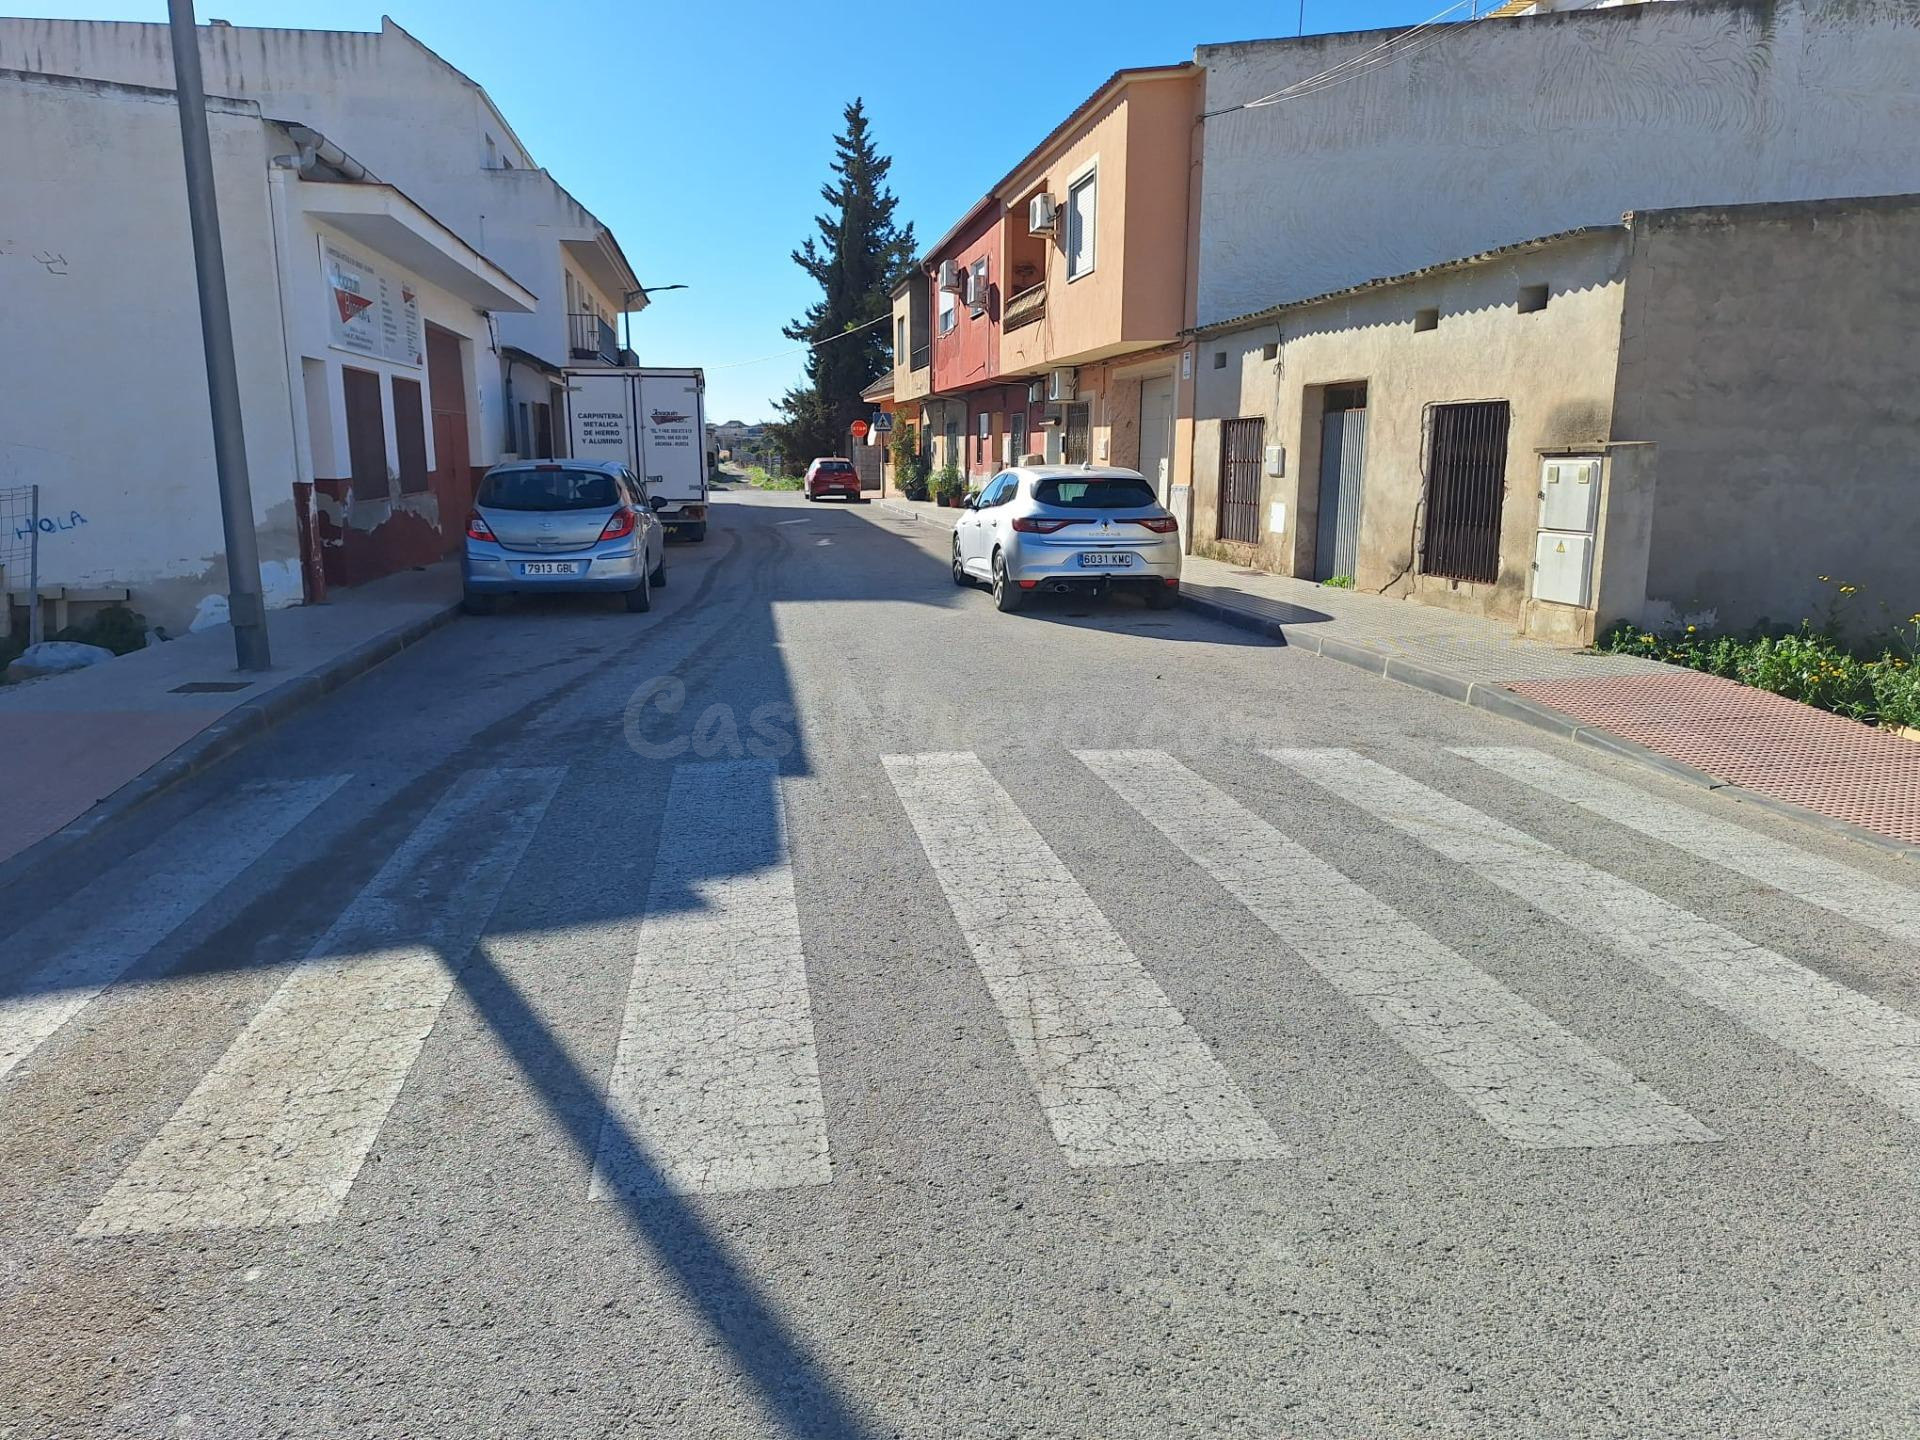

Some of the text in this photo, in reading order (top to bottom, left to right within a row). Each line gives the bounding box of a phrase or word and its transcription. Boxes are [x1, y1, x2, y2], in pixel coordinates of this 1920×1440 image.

[15, 510, 88, 540] HOLA
[1084, 555, 1131, 564] 6031 KMC
[527, 563, 576, 574] 7913 GBL
